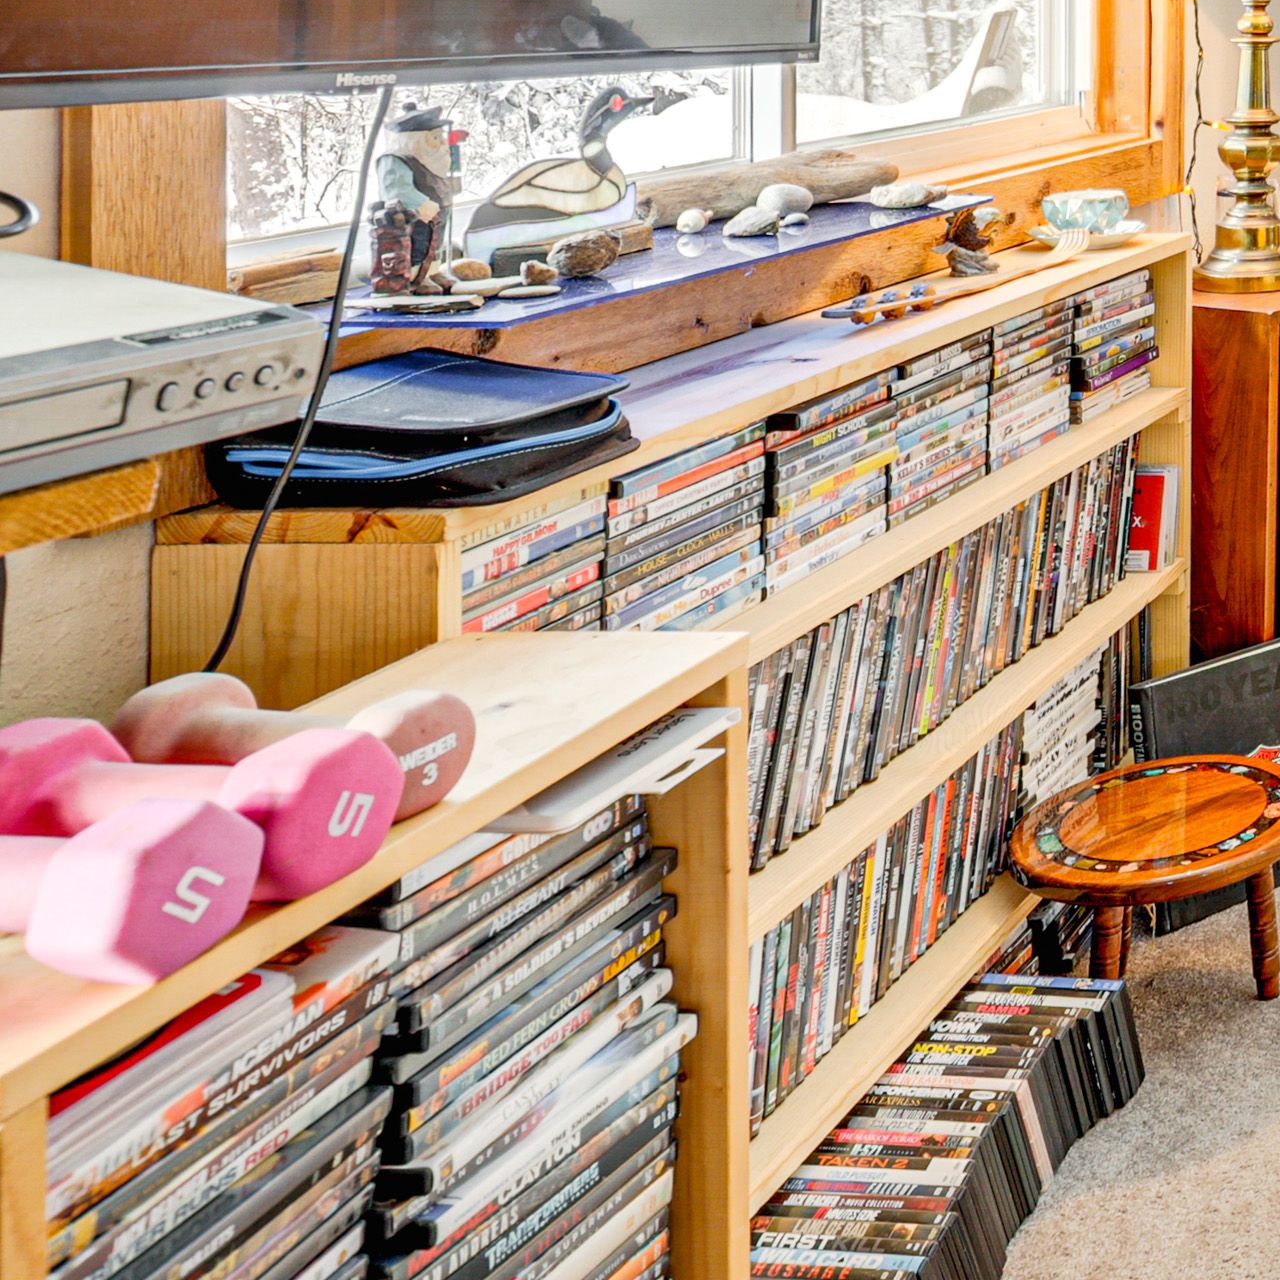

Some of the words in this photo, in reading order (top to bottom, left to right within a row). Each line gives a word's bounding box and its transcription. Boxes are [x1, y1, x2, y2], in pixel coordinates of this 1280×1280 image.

[336, 72, 397, 88] Hisense
[813, 428, 836, 447] NIGHT
[837, 414, 866, 437] SCHOOL
[461, 503, 547, 547] STILLWATER
[492, 536, 520, 557] HAPPY
[521, 520, 557, 544] GILMORE
[638, 554, 667, 575] HOUSE
[677, 536, 705, 557] CLOCK
[709, 523, 734, 543] WALLS
[701, 577, 731, 601] Dupree
[946, 608, 960, 671] AVATAR
[884, 633, 901, 709] DIVERGENT
[399, 732, 458, 772] WEIDER
[796, 709, 816, 772] WARRANT
[421, 762, 438, 786] 3
[327, 790, 375, 838] 5
[909, 806, 921, 864] ACCOUNTANT
[467, 857, 539, 916] HOLMES
[881, 871, 889, 904] ALONG
[947, 852, 957, 894] BOXER
[489, 868, 568, 938] ALLEGIANT
[870, 898, 879, 935] WATCH
[492, 982, 501, 1002] A
[505, 930, 574, 993] SOLDIER'S
[576, 888, 630, 941] REVENGE
[1035, 977, 1055, 986] BOY
[482, 1037, 511, 1074] RED
[513, 1011, 546, 1050] FERN
[549, 973, 597, 1024] GROWS
[977, 1006, 1031, 1014] RAMBO
[231, 996, 325, 1081] ICEMAN
[912, 1044, 997, 1056] NON-STOP
[930, 1034, 990, 1043] RETRIBUTION
[460, 1049, 531, 1119] BRIDGE
[535, 1029, 557, 1059] TOO
[561, 1003, 591, 1040] FAR
[902, 1065, 945, 1076] EXPRESS
[907, 1054, 924, 1063] THE
[923, 1054, 974, 1066] COMMUTER
[131, 1105, 204, 1169] LAST
[208, 1006, 346, 1117] SURVIVORS
[917, 1077, 976, 1085] EASTWOOD
[881, 1096, 922, 1106] EXPRESS
[902, 1109, 937, 1120] WORLDS
[550, 1128, 565, 1147] THE
[571, 1094, 608, 1131] SHINING
[839, 1131, 855, 1141] THE
[855, 1131, 878, 1142] MASK
[890, 1134, 921, 1144] ZORRO
[476, 1144, 492, 1165] OF
[497, 1129, 580, 1205] CLAYTON
[817, 1156, 889, 1168] TAKEN
[893, 1159, 909, 1168] 2
[174, 1165, 236, 1224] RUNS
[244, 1126, 288, 1172] RED
[827, 1170, 848, 1179] COLD
[849, 1172, 886, 1181] PURSUIT
[867, 1182, 918, 1195] FALLOUT
[485, 1161, 598, 1273] TRANSFORMERS
[783, 1194, 806, 1206] JACK
[805, 1194, 840, 1207] REACHER
[866, 1199, 905, 1209] COLLECTION
[824, 1209, 856, 1220] MINUTES
[449, 1204, 518, 1274] ANDREAS
[555, 1192, 622, 1259] SUPERMAN
[756, 1232, 836, 1250] FIRST
[831, 1235, 886, 1252] KILL
[792, 1220, 826, 1234] LAND
[827, 1222, 844, 1235] OF
[840, 1222, 870, 1237] BAD
[752, 1263, 852, 1279] HOSTAGE
[756, 1248, 816, 1265] WILD
[815, 1251, 884, 1269] CARD
